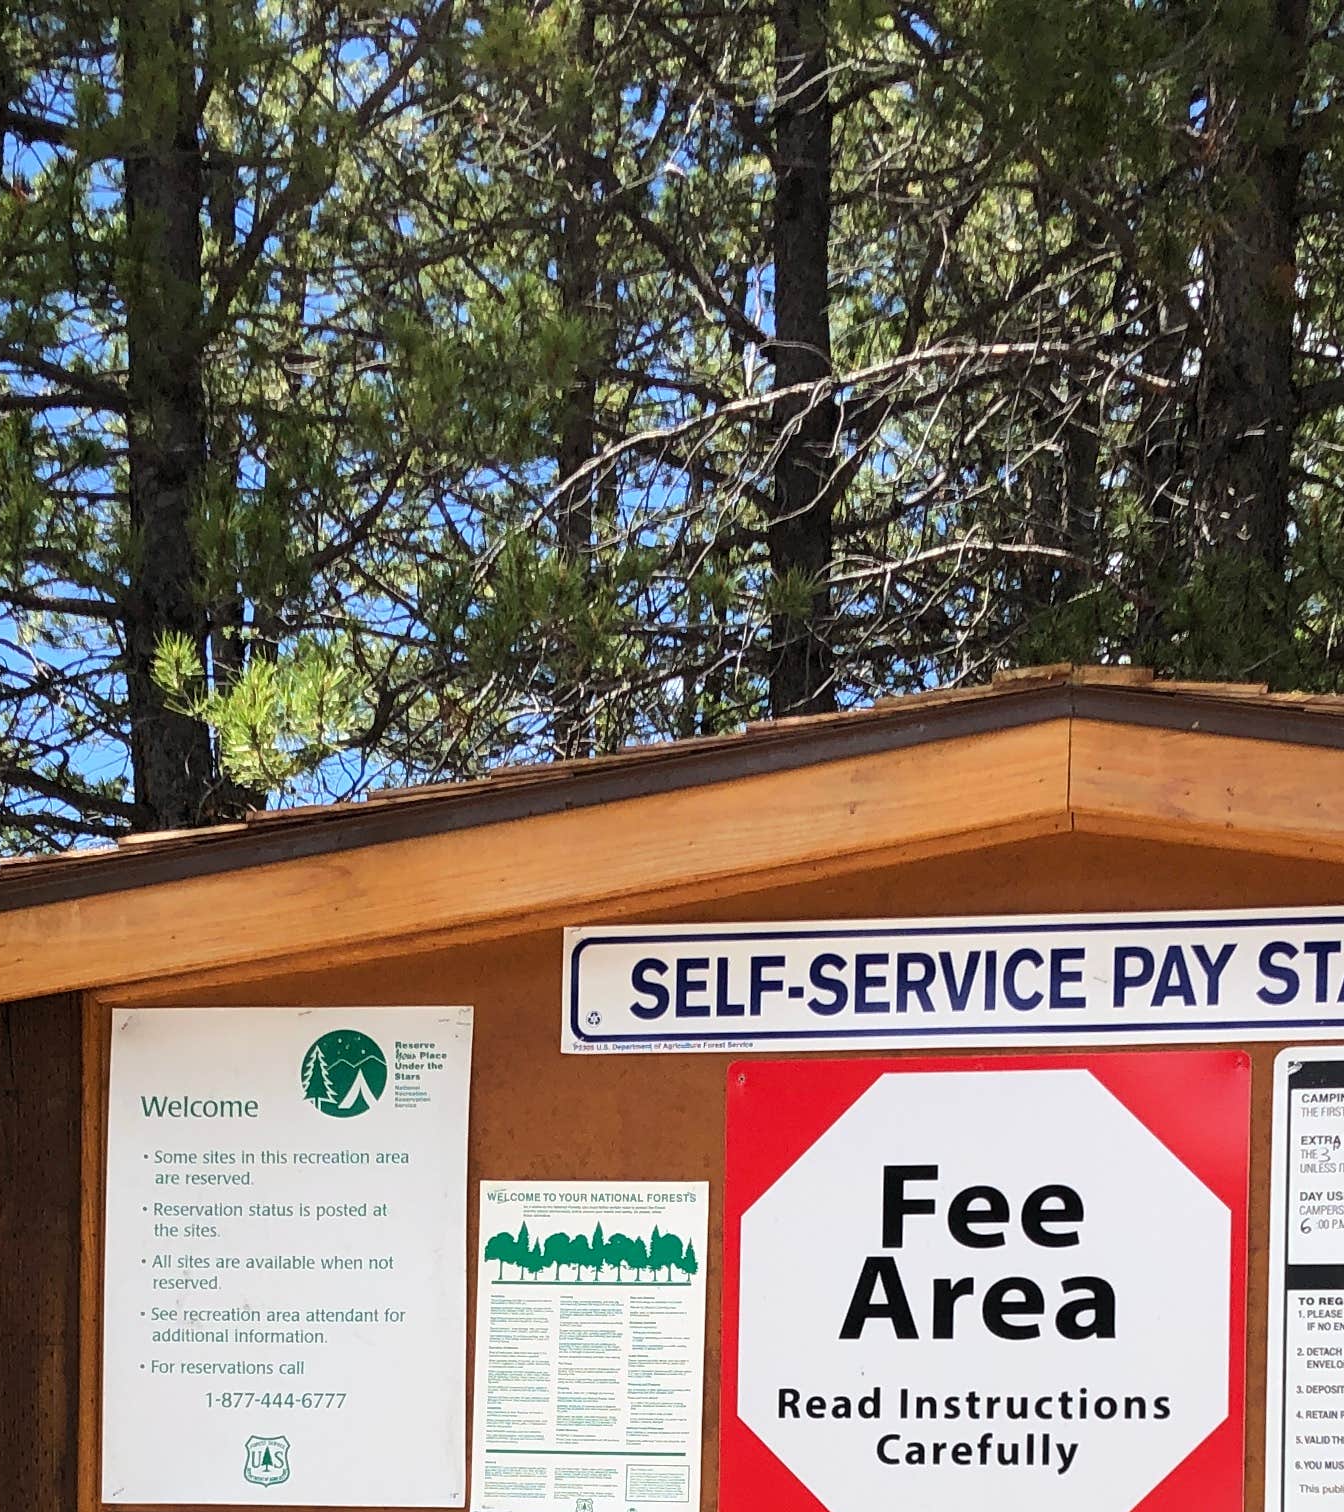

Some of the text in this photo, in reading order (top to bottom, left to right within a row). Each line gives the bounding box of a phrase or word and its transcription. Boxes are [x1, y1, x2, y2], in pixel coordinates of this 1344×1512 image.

[629, 947, 1086, 1020] SELF-SERVICE
[1113, 943, 1237, 1007] PAY
[394, 1041, 435, 1050] Reserve
[394, 1062, 443, 1070] Under the
[394, 1072, 420, 1080] Stars
[140, 1095, 258, 1117] Welcome
[1300, 1135, 1341, 1145] EXTRA
[154, 1149, 408, 1164] Some sites in this recreation area
[486, 1191, 696, 1203] WELCOME TO YOUR NATIONAL FORESTS
[1299, 1191, 1323, 1201] DAY
[882, 1164, 1084, 1248] Fee
[838, 1256, 1115, 1340] Area
[1297, 1297, 1315, 1306] TO
[205, 1392, 346, 1408] 1-877-444-6777
[778, 1386, 1170, 1419] Read Instructions
[876, 1432, 1078, 1474] Carefully
